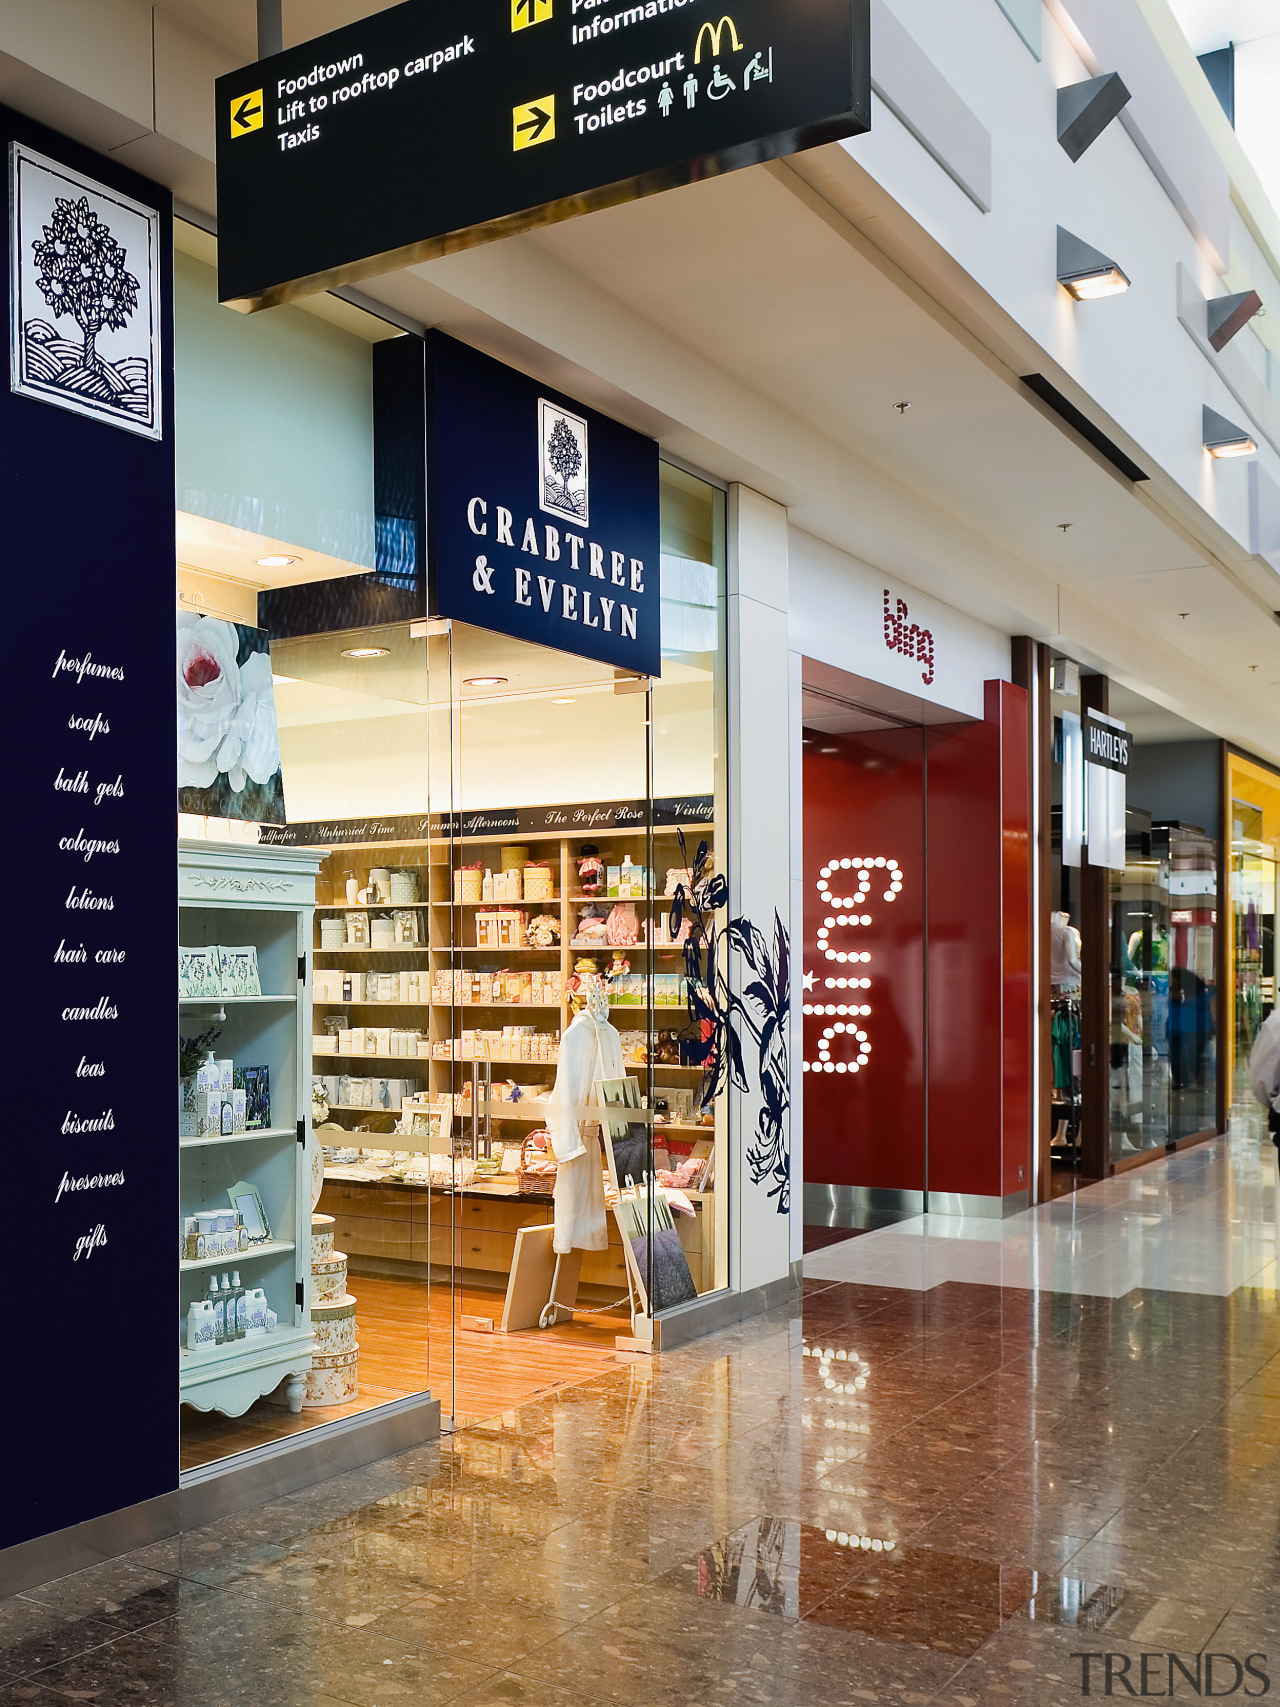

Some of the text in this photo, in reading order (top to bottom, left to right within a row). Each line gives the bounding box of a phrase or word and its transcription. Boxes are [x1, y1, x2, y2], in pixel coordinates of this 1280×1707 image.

[572, 0, 697, 45] Informati
[277, 53, 364, 98] Foodtown
[278, 35, 475, 125] Lift to rooftop carpark
[573, 51, 685, 105] Foodcourt
[574, 98, 647, 134] Toilets
[277, 123, 320, 151] Taxis
[467, 497, 645, 594] CRABTREE
[472, 555, 638, 640] & EVELYN
[52, 650, 124, 683] perfumes
[68, 713, 110, 740] soaps
[1090, 726, 1128, 765] HARTLEYS
[54, 768, 124, 805] bath gels
[261, 830, 296, 845] allpaper
[317, 823, 367, 838] Unhurried
[369, 823, 395, 835] Time
[463, 816, 519, 833] Afternoons
[545, 810, 567, 825] The
[572, 809, 612, 827] Perfect
[615, 806, 644, 820] Rose
[59, 828, 120, 862] colognes
[65, 886, 114, 910] lotions
[54, 939, 125, 963] hair care
[62, 997, 118, 1020] candles
[76, 1056, 105, 1077] teas
[61, 1109, 115, 1134] biscuits
[55, 1170, 125, 1203] preserves
[73, 1224, 107, 1261] gifts
